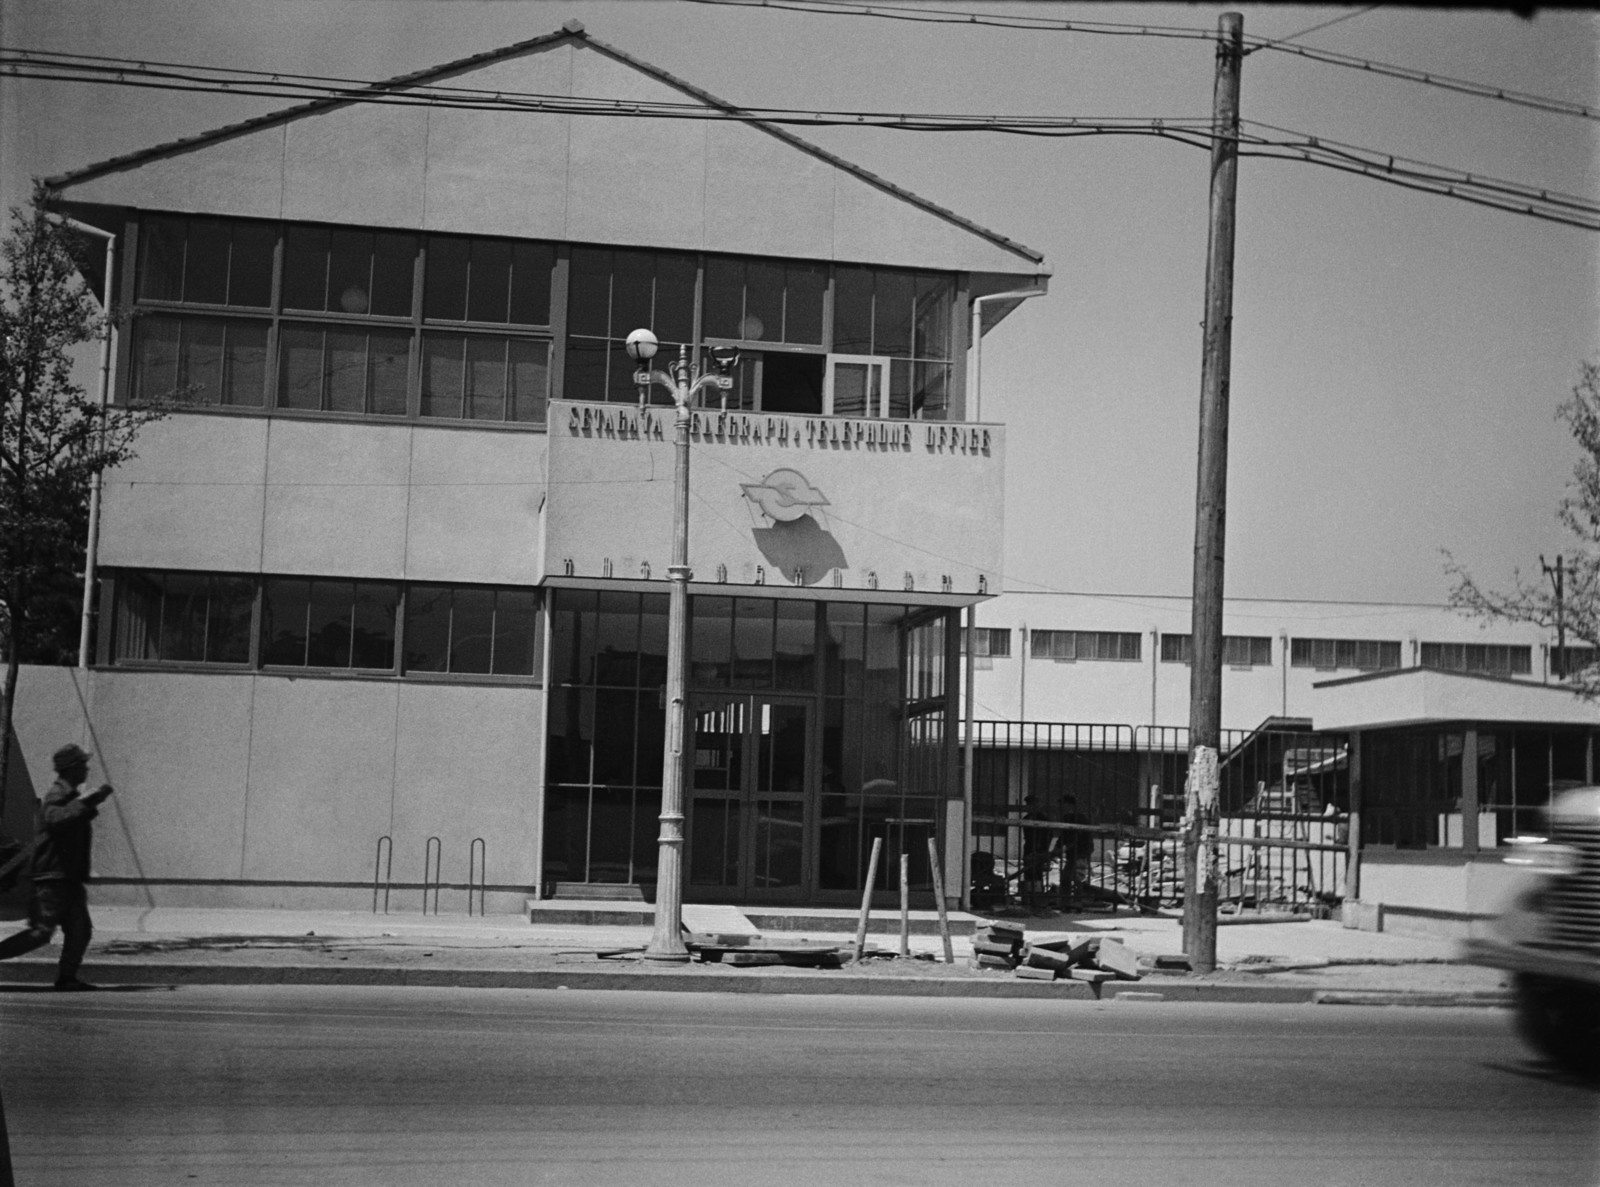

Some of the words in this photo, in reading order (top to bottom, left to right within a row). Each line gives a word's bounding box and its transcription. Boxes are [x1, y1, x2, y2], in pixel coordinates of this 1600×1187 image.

[568, 406, 663, 436] SETAGAYA
[682, 411, 788, 441] ELEGRAPH
[805, 418, 912, 448] TELEPHONE
[926, 425, 992, 453] OFFICE
